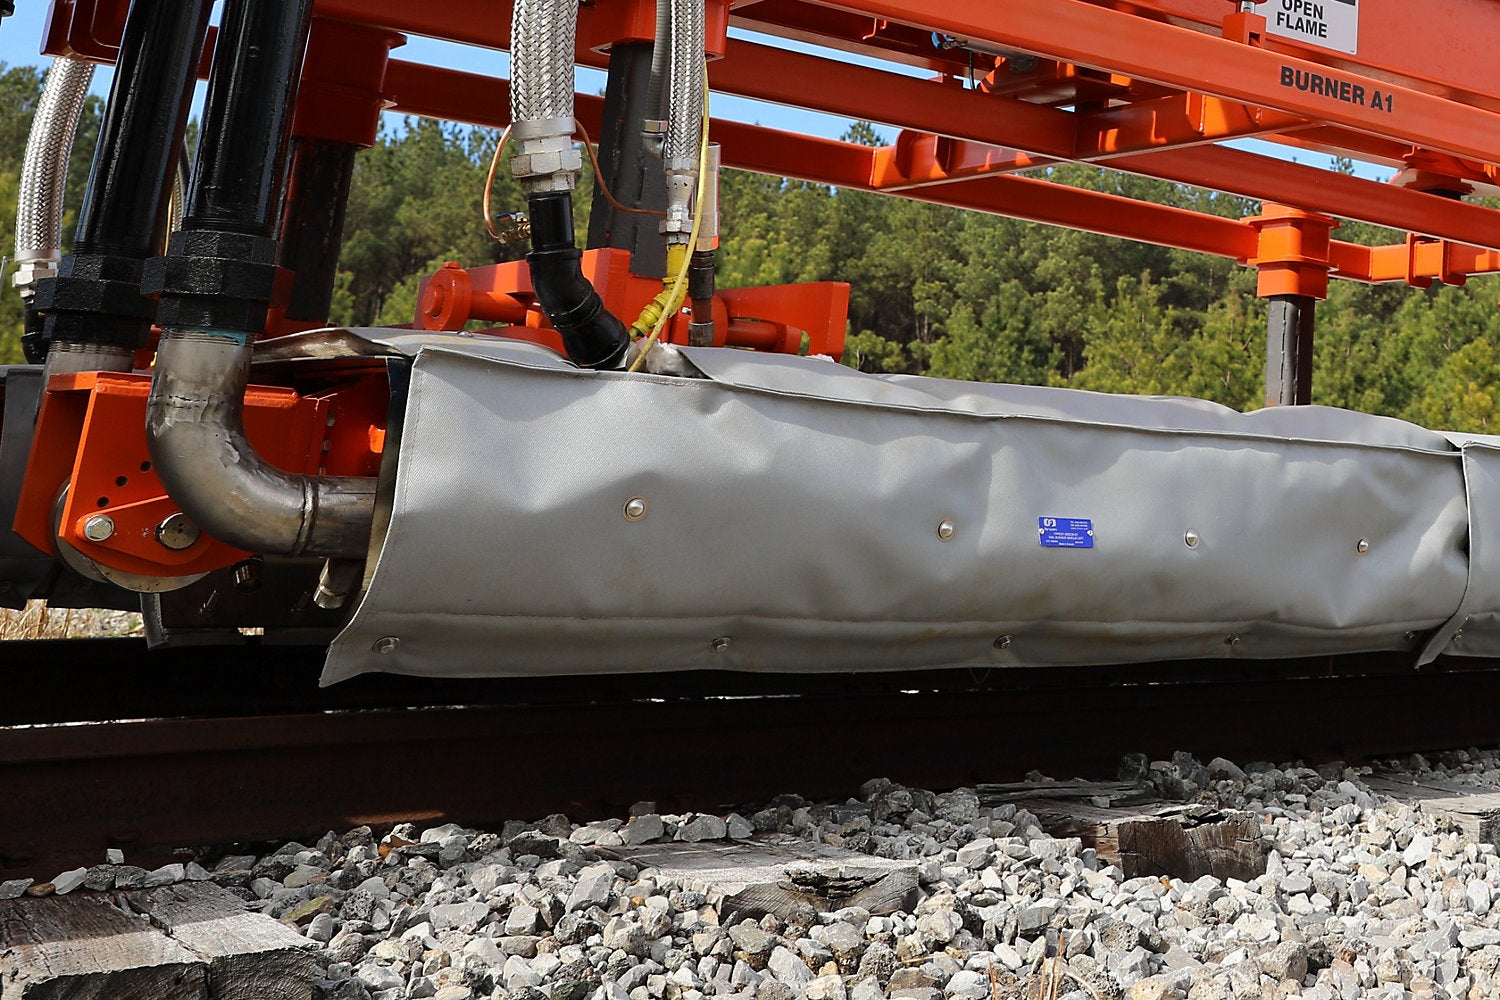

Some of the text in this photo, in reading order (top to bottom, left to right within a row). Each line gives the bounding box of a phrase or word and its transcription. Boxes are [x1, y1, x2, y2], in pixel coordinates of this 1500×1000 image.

[1276, 11, 1328, 39] FLAME
[1280, 65, 1393, 113] BURNER A1
